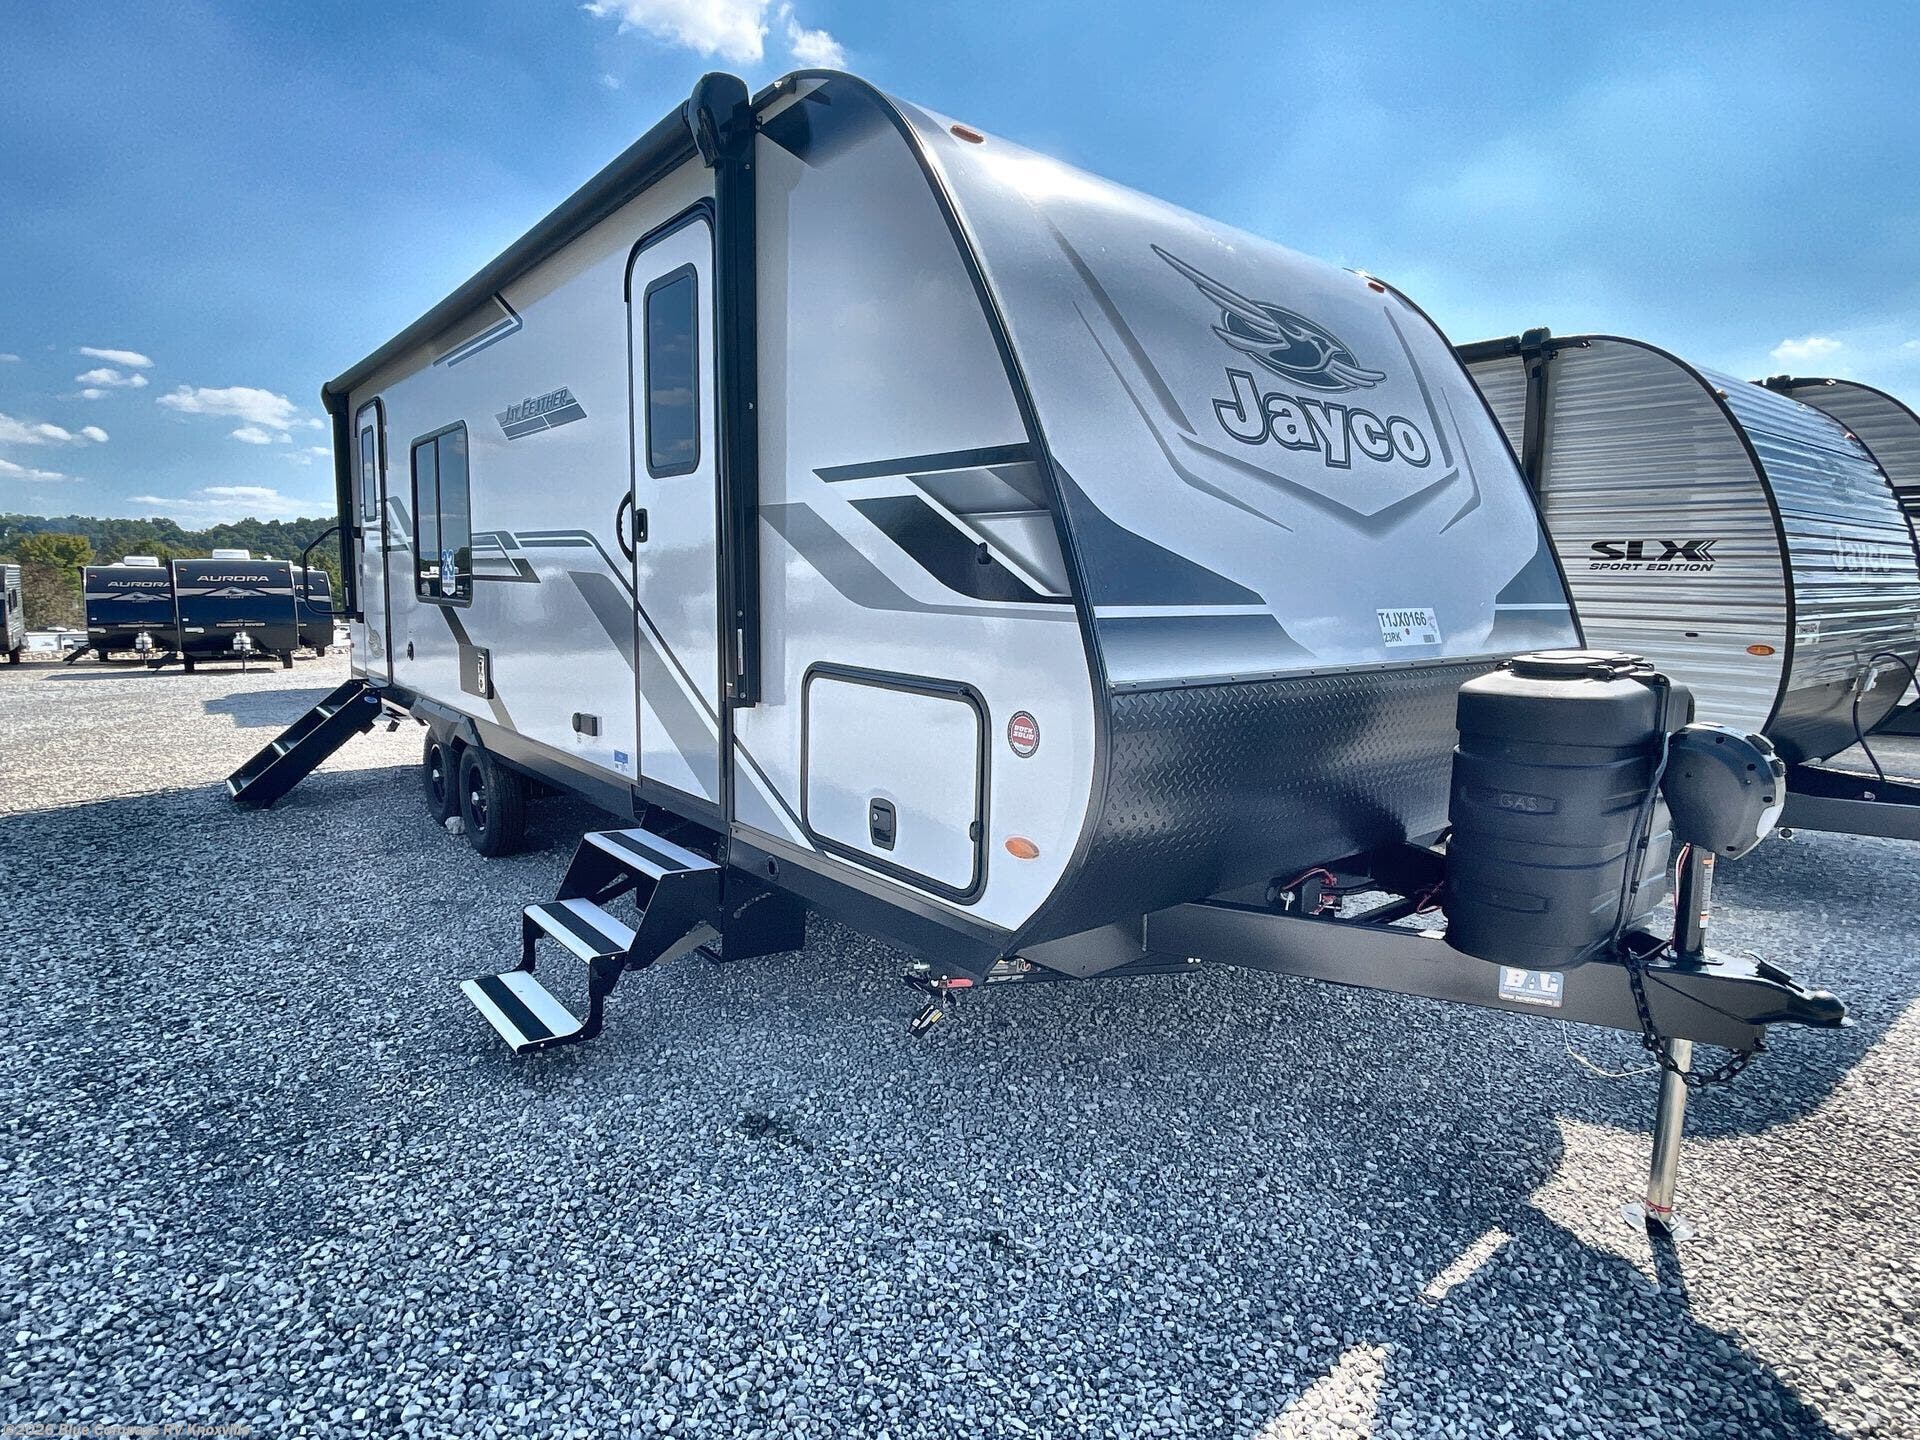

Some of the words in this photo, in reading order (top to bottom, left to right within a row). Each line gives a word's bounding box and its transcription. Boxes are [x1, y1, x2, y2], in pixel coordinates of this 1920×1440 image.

[521, 389, 568, 418] FEATHER
[1211, 366, 1431, 469] Jayco
[1589, 540, 1717, 562] SLX
[1831, 529, 1891, 578] Jayco
[1589, 563, 1642, 571] SPORT
[1646, 563, 1714, 572] EDITION
[1378, 611, 1427, 628] T1JX0166
[1383, 632, 1402, 643] 23RK
[1500, 793, 1538, 811] GAS
